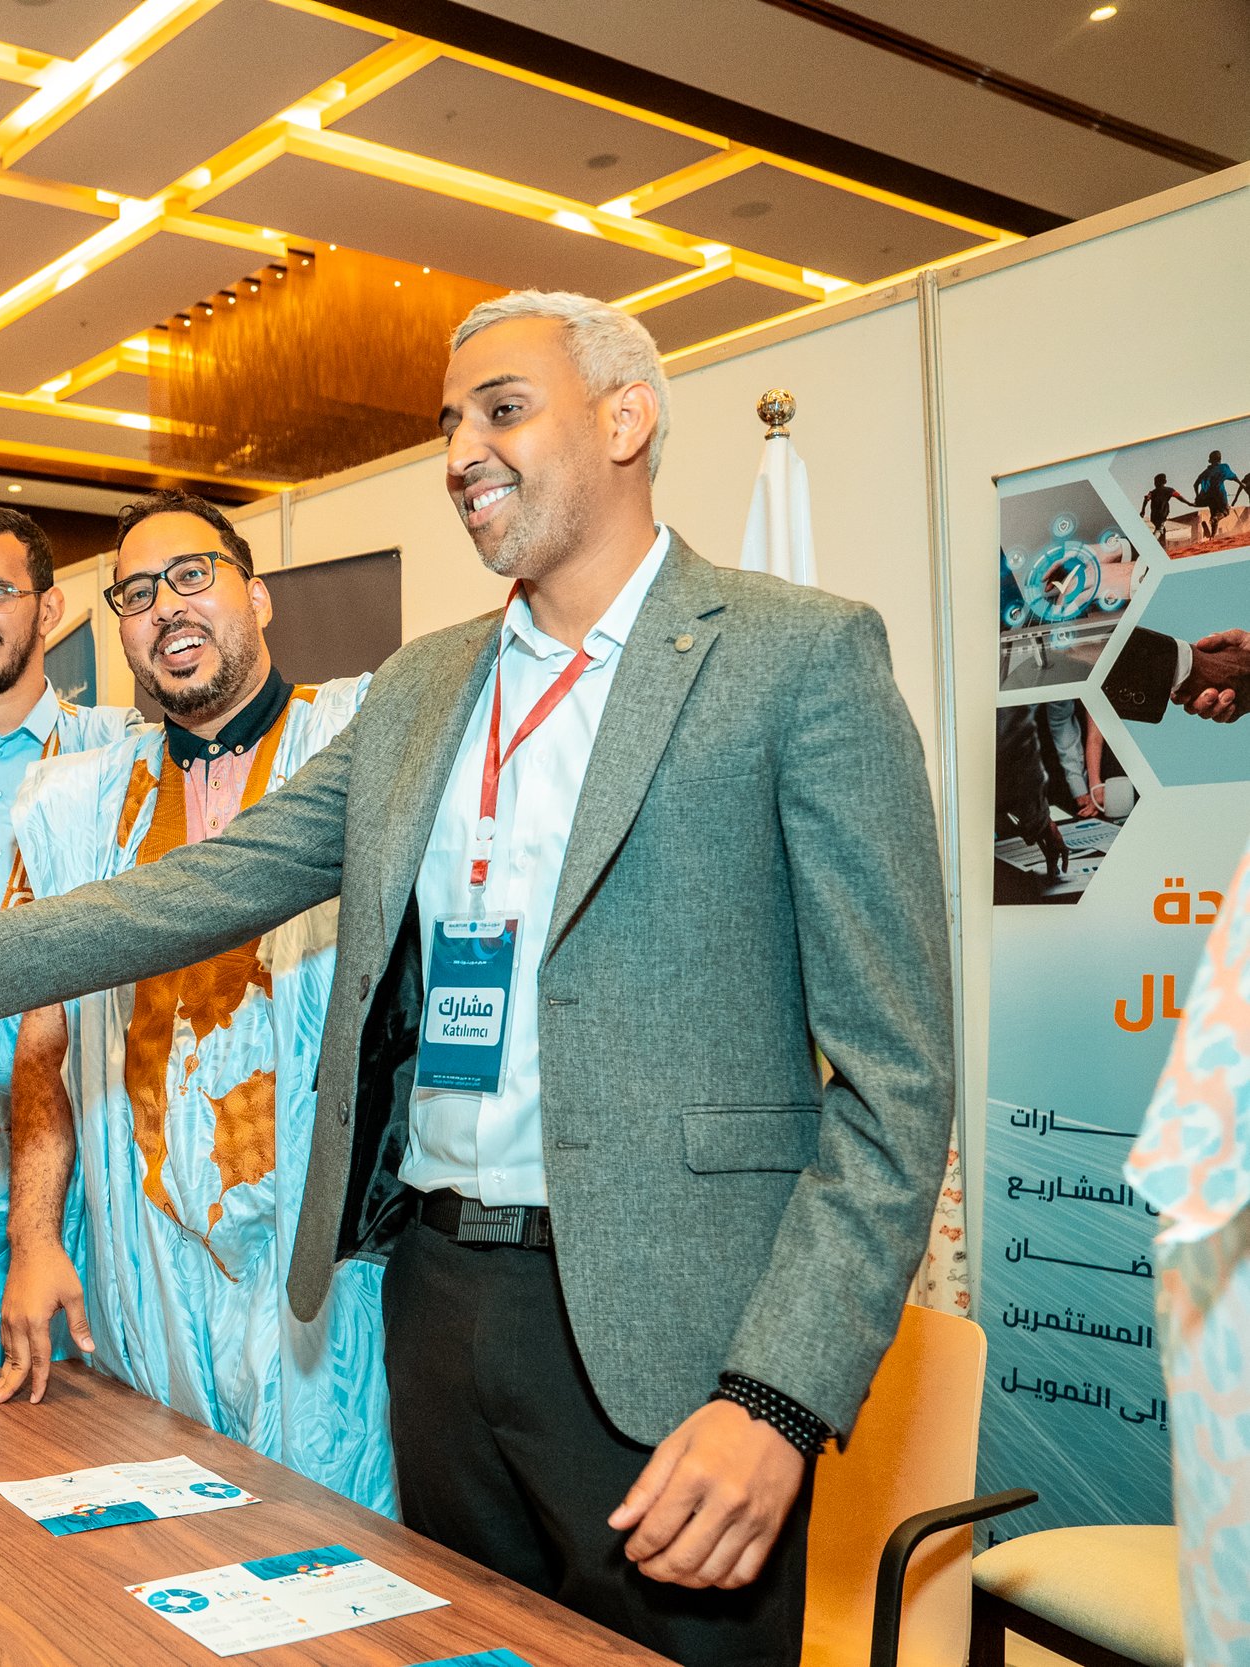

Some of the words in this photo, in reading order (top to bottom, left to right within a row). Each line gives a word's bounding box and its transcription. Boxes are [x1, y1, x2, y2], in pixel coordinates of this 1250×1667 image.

[1153, 877, 1225, 925] دة
[438, 994, 494, 1023] مشارك
[1114, 974, 1187, 1033] ال
[442, 1023, 489, 1038] Katılımcı
[1010, 1108, 1141, 1138] ارات
[1004, 1237, 1155, 1279] ضان
[1002, 1302, 1153, 1349] المستثمرين
[1000, 1366, 1111, 1410] التمويل
[1118, 1398, 1168, 1431] إلى
